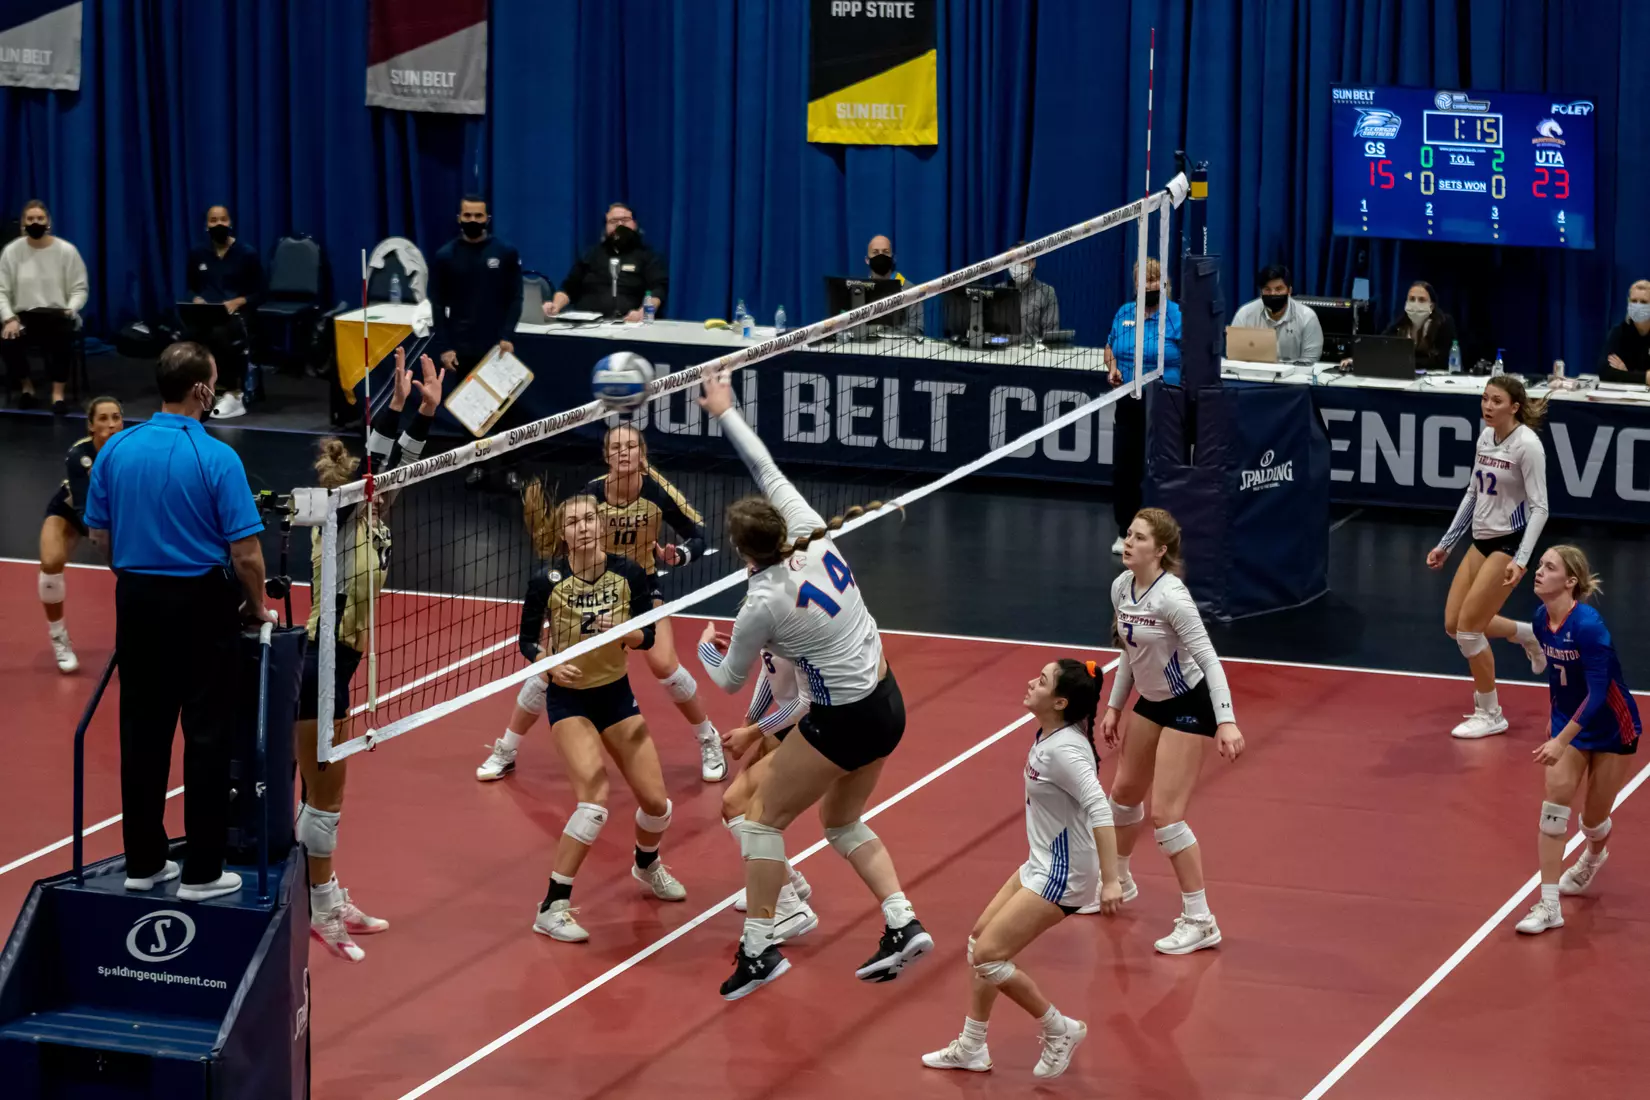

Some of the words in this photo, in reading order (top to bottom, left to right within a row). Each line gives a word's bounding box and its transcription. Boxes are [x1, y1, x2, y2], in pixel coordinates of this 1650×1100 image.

[831, 1, 862, 17] APP
[866, 2, 915, 18] STATE
[22, 48, 53, 66] BELT
[391, 69, 420, 86] SUN
[422, 70, 457, 87] BELT
[1332, 88, 1353, 100] SUN
[1353, 90, 1375, 101] BELT
[836, 102, 868, 119] SUN
[871, 103, 907, 120] BELT
[1551, 103, 1590, 116] FOLEY
[1454, 118, 1497, 143] 1:15
[1365, 142, 1386, 154] GS
[1420, 146, 1433, 168] 0
[1536, 150, 1564, 164] UTA
[1451, 154, 1474, 164] T.O.L.
[1492, 150, 1505, 172] 2
[1369, 159, 1395, 189] 15
[1420, 171, 1434, 195] 0
[1532, 167, 1569, 198] 23
[1439, 180, 1462, 190] SETS
[1463, 181, 1486, 191] WON
[1492, 175, 1505, 199] 0
[1361, 199, 1368, 211] 1
[1426, 202, 1433, 214] 2
[1491, 206, 1499, 217] 3
[1557, 210, 1565, 221] 4
[783, 371, 966, 453] BELT
[509, 430, 525, 446] SUN
[526, 420, 543, 439] BELT
[543, 407, 586, 434] VOLLEYBALL
[390, 466, 408, 484] BELT
[409, 450, 457, 479] VOLLEYBALL
[1240, 460, 1294, 490] SPALDING
[1475, 470, 1498, 496] 12
[609, 513, 649, 528] AGLES
[614, 530, 637, 546] 10
[796, 550, 855, 619] 14
[567, 588, 619, 608] EAGLES
[1122, 622, 1138, 648] 2
[1553, 664, 1567, 686] 7
[97, 965, 227, 990] spaldingequipment.com
